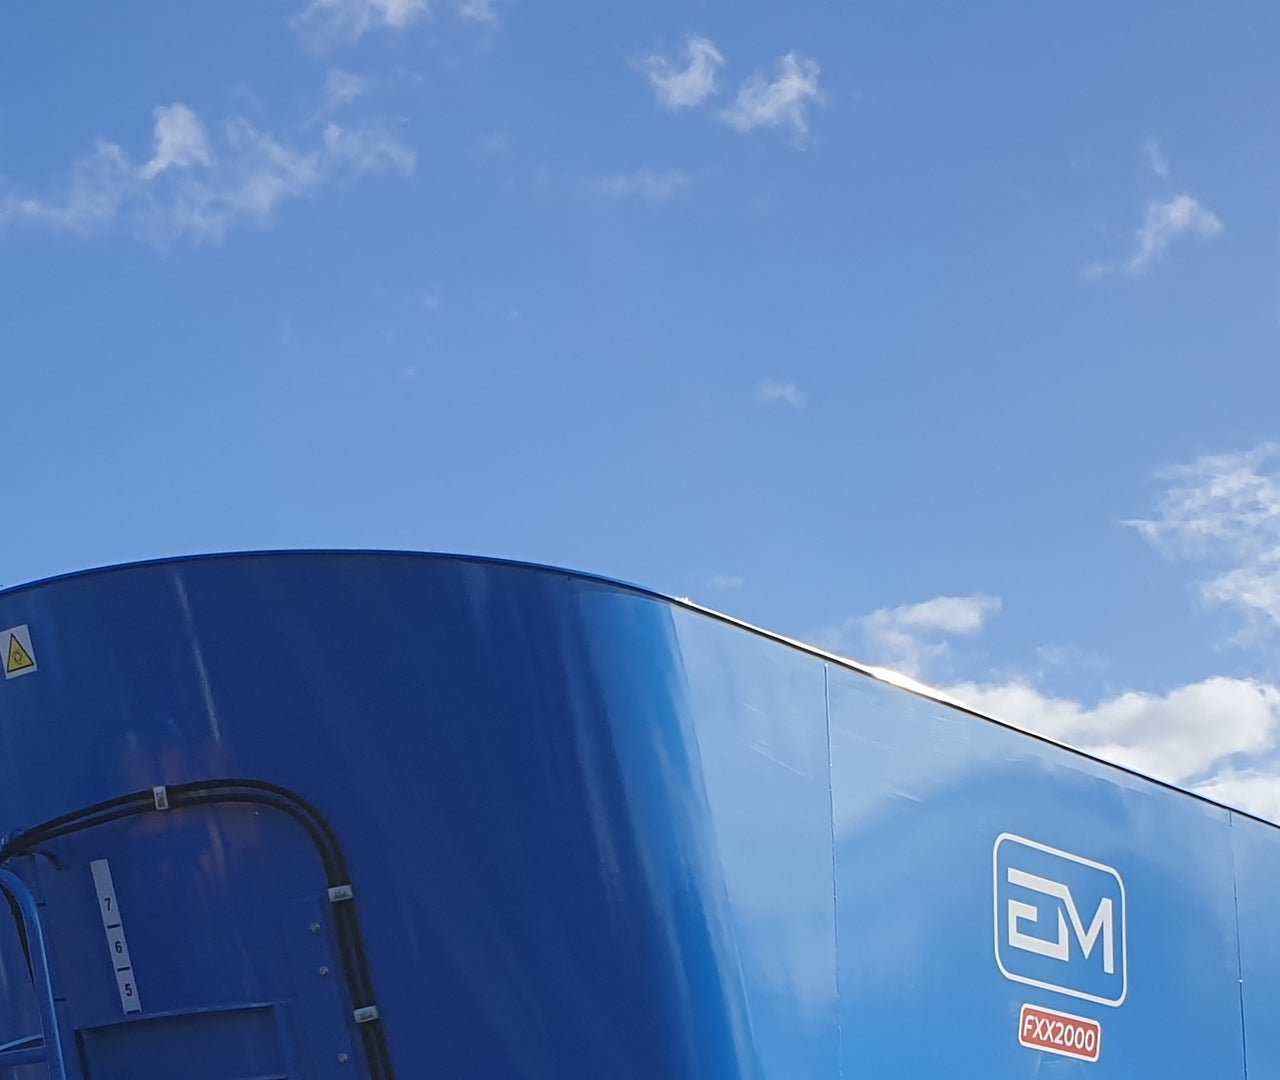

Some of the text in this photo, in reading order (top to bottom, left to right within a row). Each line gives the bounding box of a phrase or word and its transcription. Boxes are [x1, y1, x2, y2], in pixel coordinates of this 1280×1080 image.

[103, 897, 112, 911] 7
[1007, 867, 1114, 975] EM
[114, 940, 123, 954] 6
[124, 983, 133, 997] 5
[1022, 1014, 1096, 1052] FXX2000
